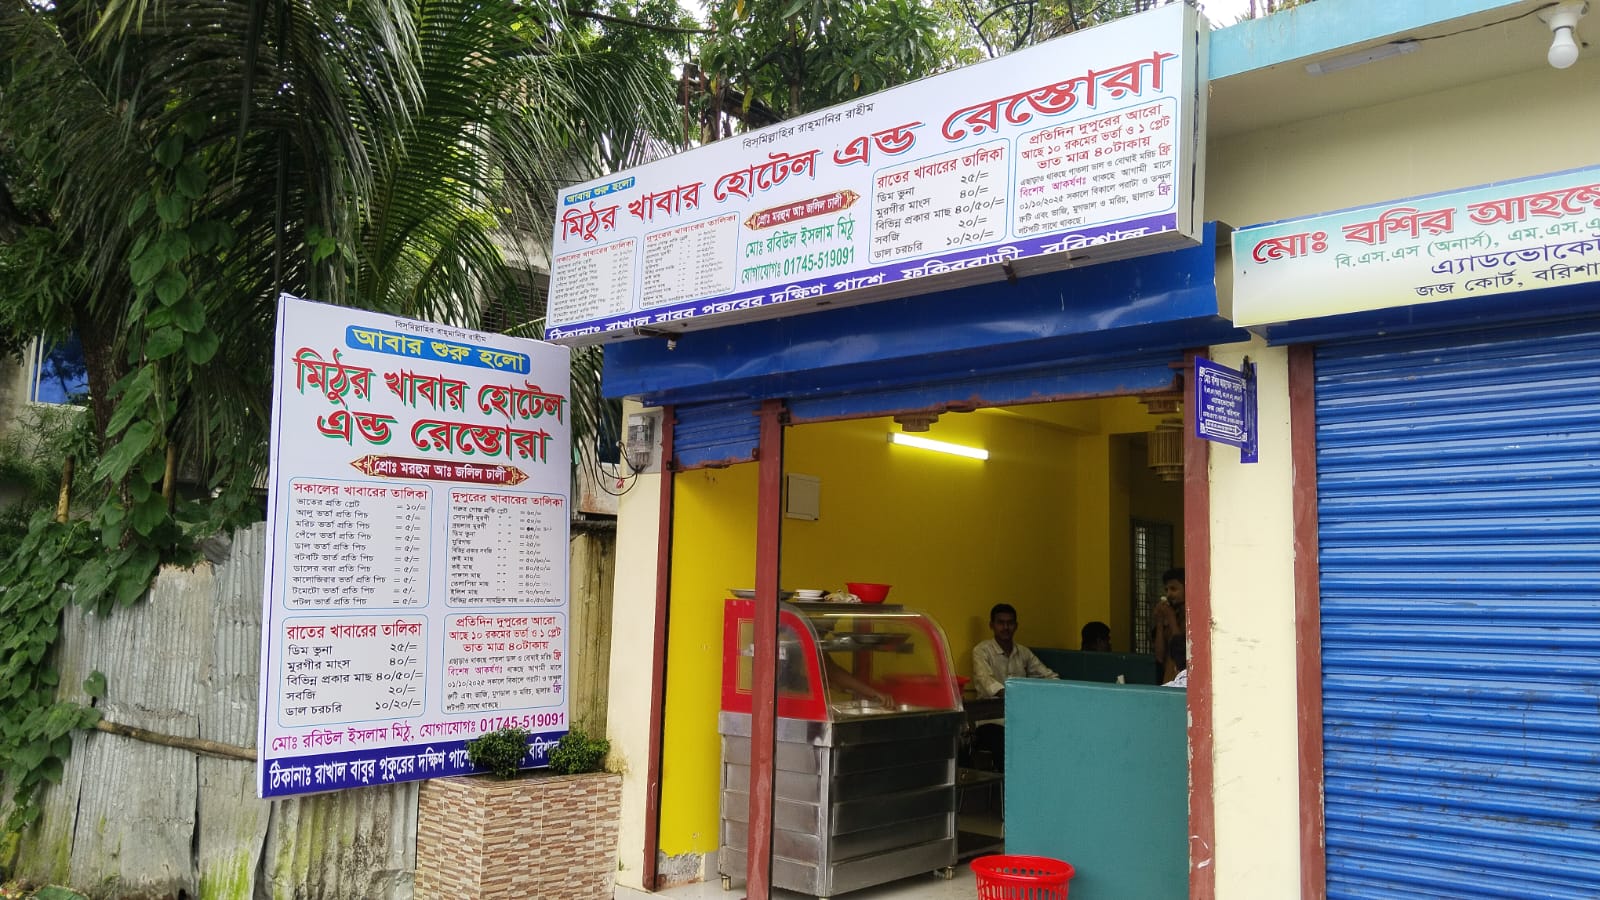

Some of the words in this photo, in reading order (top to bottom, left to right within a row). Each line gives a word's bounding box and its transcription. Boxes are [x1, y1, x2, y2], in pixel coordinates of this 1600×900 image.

[845, 103, 875, 119] রাহীম
[1029, 124, 1074, 145] প্রতিদিন
[1079, 114, 1120, 134] দুপুরের
[1126, 103, 1162, 120] আরো
[561, 201, 621, 241] মিঠুর
[627, 182, 704, 220] খাবার
[714, 149, 822, 204] হোটেল
[833, 121, 925, 166] এন্ড
[942, 51, 1178, 141] রেস্তোরা
[1021, 147, 1044, 160] আছে
[1048, 146, 1060, 155] ১০
[1064, 135, 1097, 151] রকমের
[1101, 126, 1122, 141] ভর্তা
[1126, 126, 1133, 135] ও
[1139, 125, 1144, 133] ১
[1150, 116, 1171, 131] প্লেট
[877, 171, 910, 188] রাতের
[914, 159, 958, 178] খাবারের
[962, 147, 1004, 167] তালিকা
[1037, 156, 1061, 169] ভাত
[1067, 150, 1088, 162] মাত্র
[567, 191, 591, 203] আবার
[594, 185, 609, 197] শুরু
[613, 178, 633, 192] হলো
[877, 192, 895, 203] ডিম
[897, 186, 915, 200] ভুনা
[961, 171, 989, 184] ২৫/=
[1020, 185, 1044, 198] বিশেষ
[772, 208, 791, 223] মরহুম
[793, 204, 804, 216] আঃ
[806, 199, 825, 213] জলিল
[827, 194, 842, 208] ঢালী
[876, 204, 904, 218] মুরগীর
[909, 198, 931, 209] মাংস
[960, 185, 989, 198] ৪০/=
[876, 218, 901, 231] বিভিন্ন
[904, 212, 929, 225] প্রকার
[934, 208, 951, 219] মাছ
[955, 197, 1005, 214] ৪০/৫০/=
[1020, 194, 1063, 210] ০১/১০/২০২৫
[745, 237, 763, 258] মোঃ
[767, 230, 797, 254] রবিউল
[800, 223, 834, 248] ইসলাম
[837, 213, 855, 240] মিঠু
[875, 231, 900, 244] সবজি
[959, 216, 987, 228] ২০/=
[1253, 231, 1328, 263] মোঃ
[1342, 207, 1457, 246] বশির
[1507, 216, 1600, 242] এম.এস.এ
[874, 249, 892, 259] ডাল
[896, 241, 923, 255] চরচরি
[946, 229, 993, 246] ১০/২০/=
[741, 261, 781, 284] যোগাযোগঃ
[784, 245, 854, 275] 01745-519091
[1414, 281, 1457, 298] জজ
[1464, 268, 1524, 291] কোর্ট,
[1531, 262, 1600, 282] বরিশা
[656, 308, 696, 322] বাবর
[352, 328, 425, 356] আবার
[431, 340, 470, 362] শুরু
[478, 349, 525, 372] হলো
[292, 347, 376, 409] মিঠুর
[383, 368, 470, 413] খাবার
[477, 379, 568, 426] হোটেল
[316, 409, 399, 445] এন্ড
[410, 419, 554, 464] রেস্তোরা
[374, 458, 397, 474] প্রোঃ
[401, 462, 431, 481] মরহুম
[433, 465, 452, 479] আঃ
[454, 467, 483, 482] জলিল
[485, 468, 507, 485] ঢালী
[294, 483, 340, 495] সকালের
[344, 486, 386, 498] খাবারের
[391, 487, 428, 500] তালিকা
[452, 492, 487, 504] দুপুরের
[491, 494, 527, 505] খাবারের
[531, 496, 564, 507] তালিকা
[286, 625, 326, 640] রাতের
[330, 623, 378, 638] খাবারের
[381, 619, 422, 636] তালিকা
[448, 631, 469, 641] আছে
[471, 632, 483, 640] ১০
[485, 630, 511, 639] রকমের
[513, 627, 528, 638] ভর্তা
[456, 616, 493, 627] প্রতিদিন
[497, 617, 528, 628] দুপুরের
[531, 616, 556, 626] আরো
[288, 644, 308, 656] ডিম
[313, 645, 332, 657] ভুনা
[390, 642, 418, 652] ২৫/=
[463, 643, 483, 652] ভাত
[487, 642, 504, 651] মাত্র
[287, 659, 322, 672] মুরগীর
[326, 659, 351, 670] মাংস
[390, 656, 416, 666] ৪০/=
[287, 674, 318, 686] বিভিন্ন
[322, 674, 350, 684] প্রকার
[354, 673, 372, 682] মাছ
[376, 669, 423, 681] ৪০/৫০/=
[286, 689, 316, 700] সবজি
[388, 684, 416, 695] ২০/=
[286, 706, 307, 716] ডাল
[311, 702, 342, 714] চরচরি
[375, 698, 421, 710] ১০/২০/=
[272, 736, 298, 751] মোঃ
[302, 730, 344, 748] রবিউল
[347, 727, 388, 744] ইসলাম
[391, 720, 414, 742] মিঠু,
[419, 721, 476, 738] যোগাযোগঃ
[480, 712, 565, 732] 01745-519091
[269, 760, 311, 790] ঠিকানাঃ
[315, 761, 348, 784] রাখাল
[350, 758, 376, 784] বাবুর
[380, 754, 416, 782] পুকুরের
[418, 747, 446, 772] দক্ষিণ
